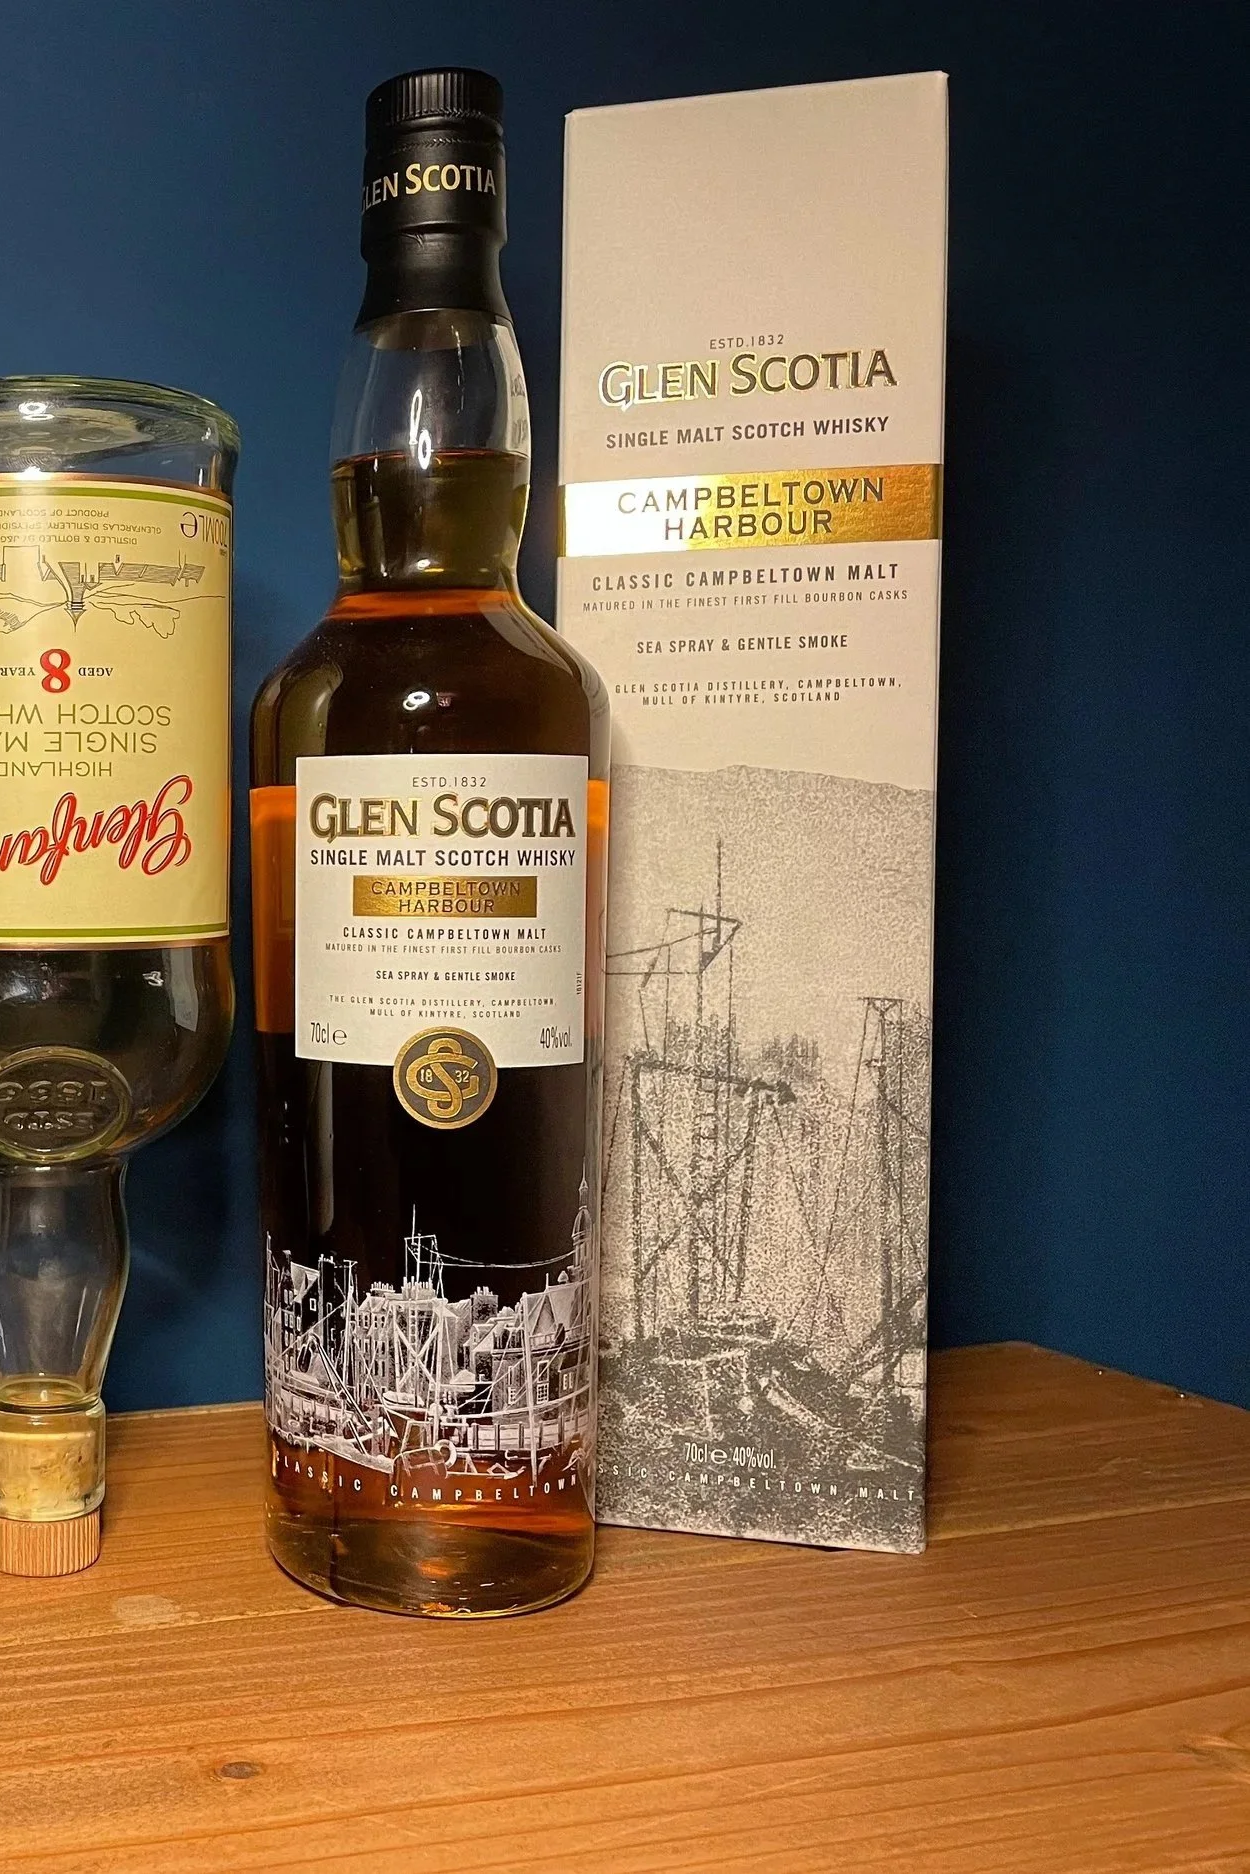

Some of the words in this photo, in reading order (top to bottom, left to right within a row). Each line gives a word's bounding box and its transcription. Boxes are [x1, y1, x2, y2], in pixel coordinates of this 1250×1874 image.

[405, 163, 496, 196] SCOTIA
[599, 360, 720, 412] GLEN
[730, 350, 898, 396] SCOTIA
[606, 430, 668, 448] SINGLE
[677, 427, 724, 444] MALT
[732, 422, 805, 441] SCOTCH
[813, 416, 889, 436] WHISKY
[618, 477, 884, 515] CAMPBELTOWN
[66, 509, 109, 517] PRODUCT
[103, 523, 162, 534] GLENFARCLAS
[665, 509, 833, 541] HARBOUR
[0, 535, 19, 543] J&G
[39, 535, 79, 543] BOTTLED
[84, 536, 90, 544] &
[94, 536, 137, 545] DISTILLED
[592, 573, 673, 591] CLASSIC
[686, 566, 835, 587] CAMPBELTOWN
[848, 564, 899, 581] MALT
[583, 599, 635, 612] MATURED
[641, 598, 653, 609] IN
[659, 598, 681, 609] THE
[686, 596, 728, 608] FINEST
[733, 594, 768, 606] FIRST
[773, 593, 799, 604] FILL
[805, 591, 863, 603] BOURBON
[869, 589, 908, 601] CASKS
[637, 641, 662, 654] SEA
[669, 639, 714, 653] SPRAY
[721, 638, 730, 651] &
[738, 636, 792, 650] GENTLE
[799, 635, 848, 649] SMOKE
[40, 648, 71, 694] 8
[78, 666, 114, 678] AGED
[615, 683, 645, 693] GLEN
[653, 682, 700, 692] SCOTIA
[642, 695, 676, 706] MULL
[682, 695, 696, 704] OF
[773, 692, 841, 702] SCOTLAND
[58, 703, 171, 726] SCOTCH
[44, 731, 157, 753] SINGLE
[310, 792, 420, 843] GLEN
[432, 792, 576, 838] SCOTIA
[310, 850, 368, 866] SINGLE
[376, 850, 426, 866] MALT
[435, 850, 508, 866] SCOTCH
[518, 850, 576, 866] WHISKY
[371, 882, 521, 896] CAMPBELTOWN
[398, 899, 494, 913] HARBOUR
[343, 927, 399, 939] CLASSIC
[407, 928, 510, 940] CAMPBELTOWN
[517, 928, 546, 940] MALT
[376, 970, 393, 980] SEA
[398, 970, 429, 981] SPRAY
[433, 971, 440, 981] &
[444, 971, 480, 981] GENTLE
[485, 971, 515, 981] SMOKE
[329, 995, 346, 1003] THE
[350, 995, 374, 1004] GLEN
[380, 996, 415, 1005] SCOTIA
[369, 1009, 394, 1017] MULL
[400, 1009, 413, 1018] OF
[473, 1010, 521, 1018] SCOTLAND
[310, 1022, 329, 1044] 70cl
[684, 1442, 708, 1464] 70cl
[390, 1473, 577, 1500] CAMPBELTOWN
[669, 1471, 837, 1496] CAMPBELTOWN
[859, 1487, 915, 1501] MALT
